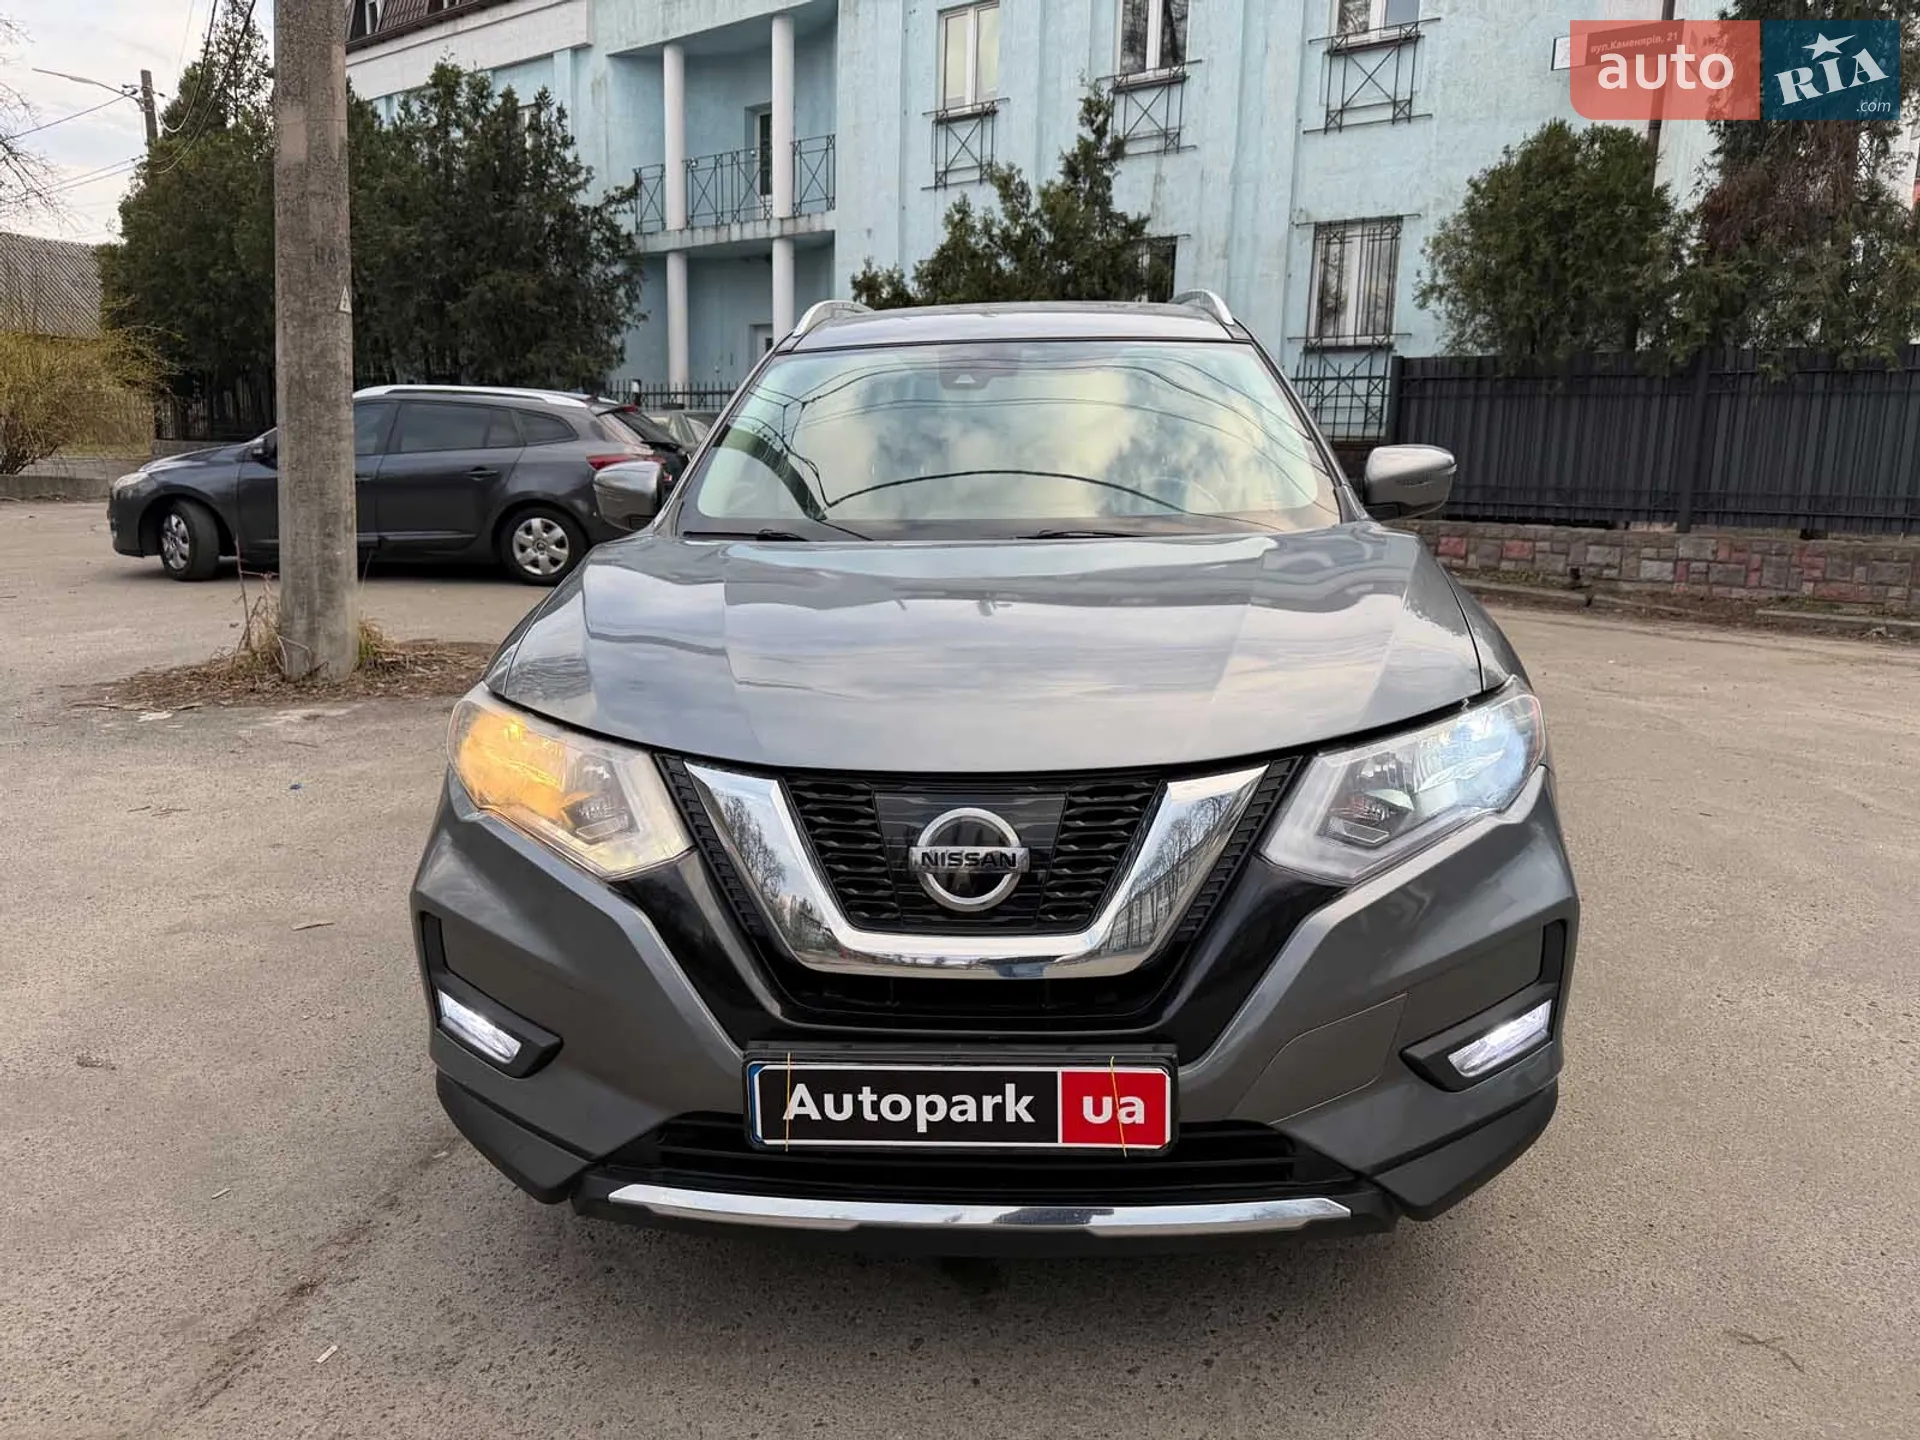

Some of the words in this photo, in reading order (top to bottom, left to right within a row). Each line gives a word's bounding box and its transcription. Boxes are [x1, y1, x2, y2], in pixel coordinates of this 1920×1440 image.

[1666, 31, 1678, 41] 21
[921, 851, 1017, 868] NISSAN
[782, 1083, 1036, 1133] Autopark
[1081, 1094, 1146, 1125] ua
